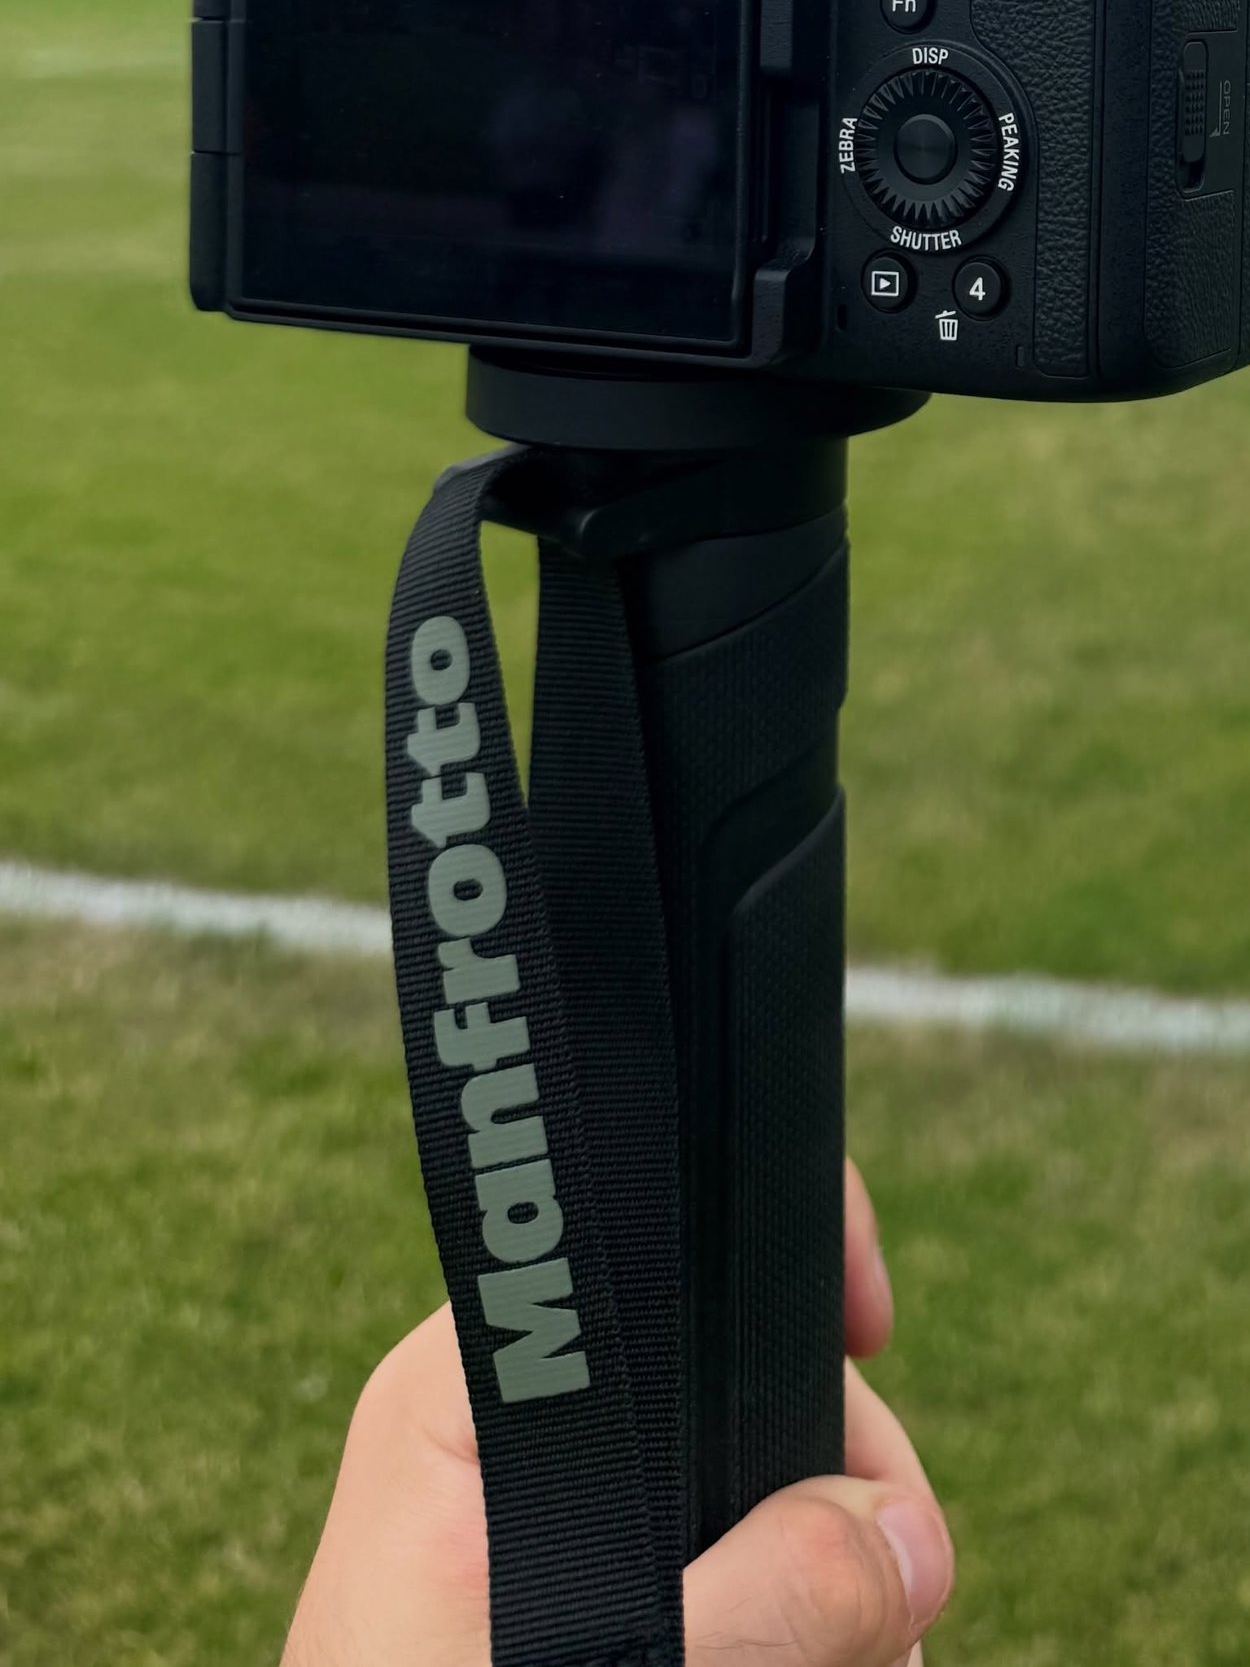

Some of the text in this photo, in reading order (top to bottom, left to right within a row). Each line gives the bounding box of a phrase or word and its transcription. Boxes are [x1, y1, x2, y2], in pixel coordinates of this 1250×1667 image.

[911, 46, 949, 65] DISP
[1222, 79, 1232, 136] OPEN
[838, 117, 858, 174] ZEBRA
[997, 112, 1020, 192] PEAKING
[890, 225, 962, 251] SHUTTER
[968, 276, 987, 302] 4
[403, 614, 591, 1406] Manfrotto
